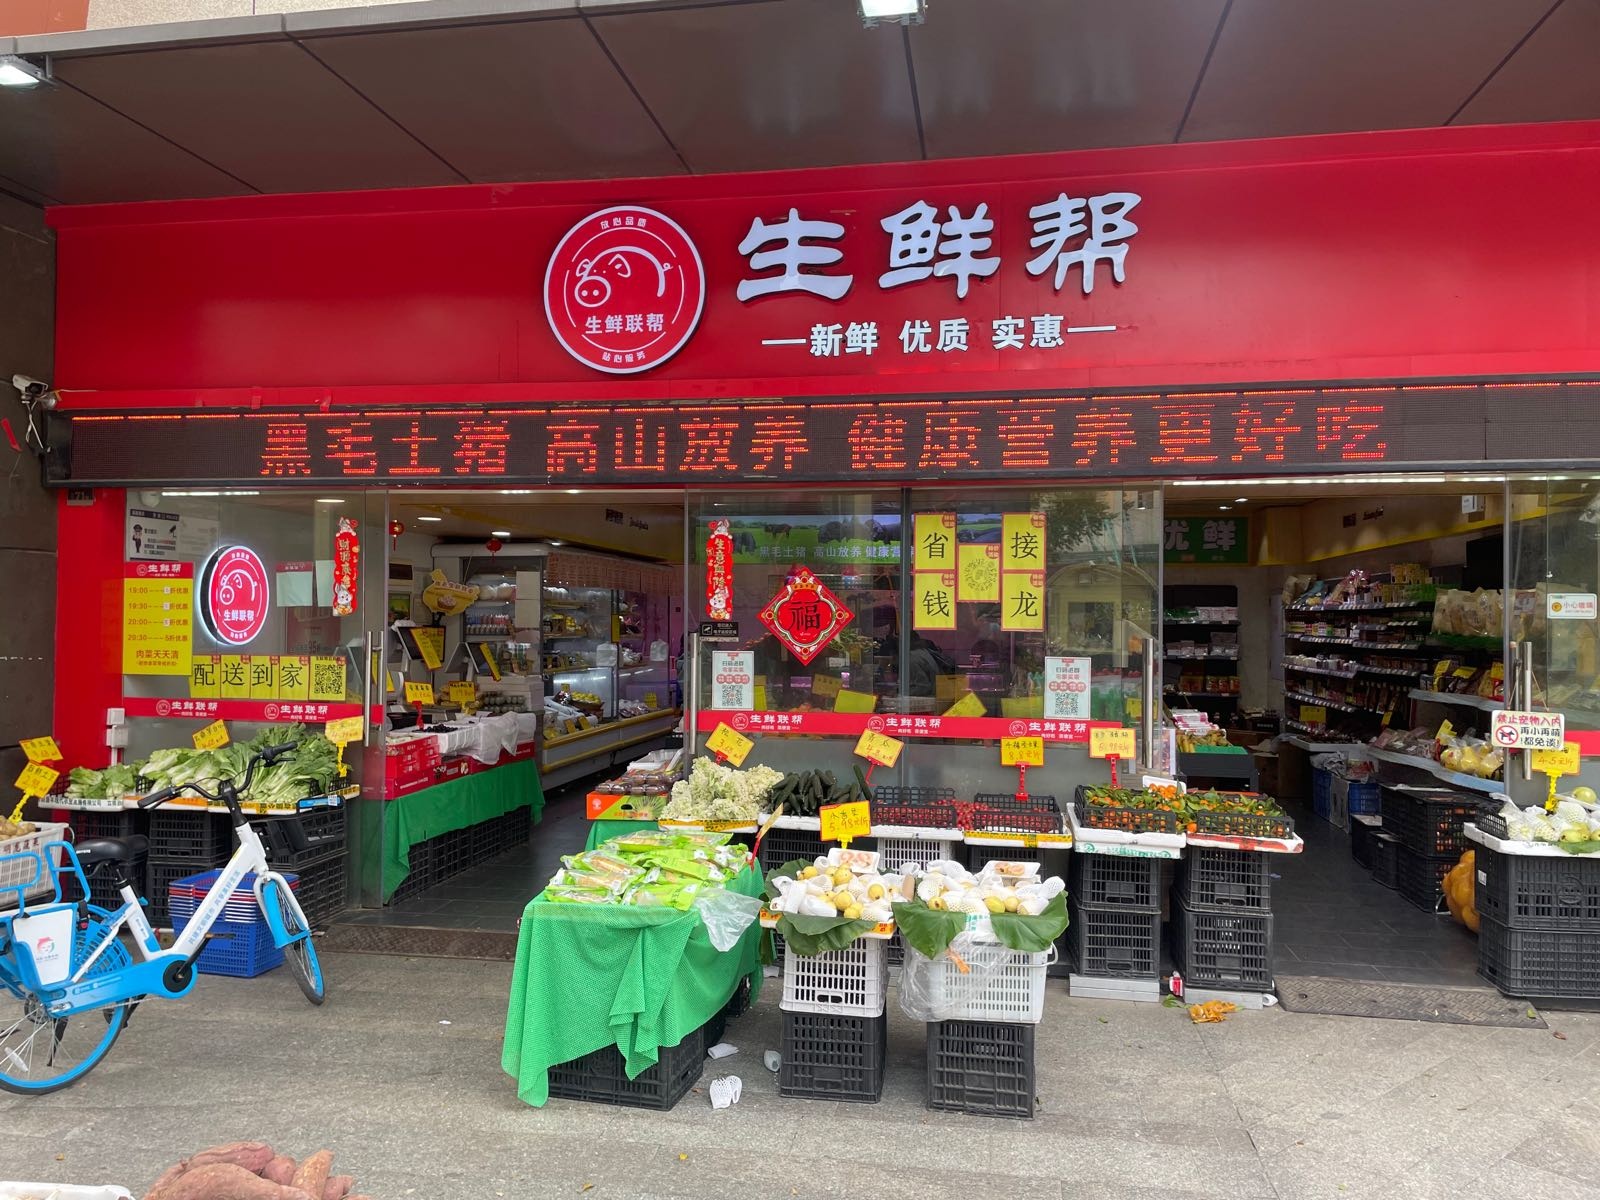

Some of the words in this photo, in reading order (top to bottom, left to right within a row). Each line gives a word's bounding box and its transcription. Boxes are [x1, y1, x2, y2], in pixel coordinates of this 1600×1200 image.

[600, 216, 647, 230] 放心品质
[736, 192, 1142, 302] 生鲜帮
[585, 313, 664, 335] 生鲜联帮
[810, 321, 879, 357] 新鲜
[899, 317, 970, 354] 优质
[991, 313, 1065, 351] 实惠
[601, 350, 647, 364] 贴心服务
[260, 418, 511, 476] 黑毛土猪
[546, 414, 808, 474] 高山放养
[848, 400, 1388, 469] 健康营养更好吃
[760, 545, 806, 559] 黑毛土猪
[814, 545, 862, 559] 高山放养
[223, 609, 255, 622] 生鲜联帮
[788, 600, 820, 631] 福
[193, 662, 303, 689] 配送到家
[171, 701, 218, 711] 生鲜联帮
[280, 705, 328, 715] 生鲜联帮
[750, 714, 803, 725] 生鲜联帮
[886, 717, 941, 729] 生鲜联帮
[1497, 713, 1561, 727] 禁止宠物入内
[1028, 721, 1087, 733] 生鲜联帮
[1520, 726, 1560, 737] 再小再萌
